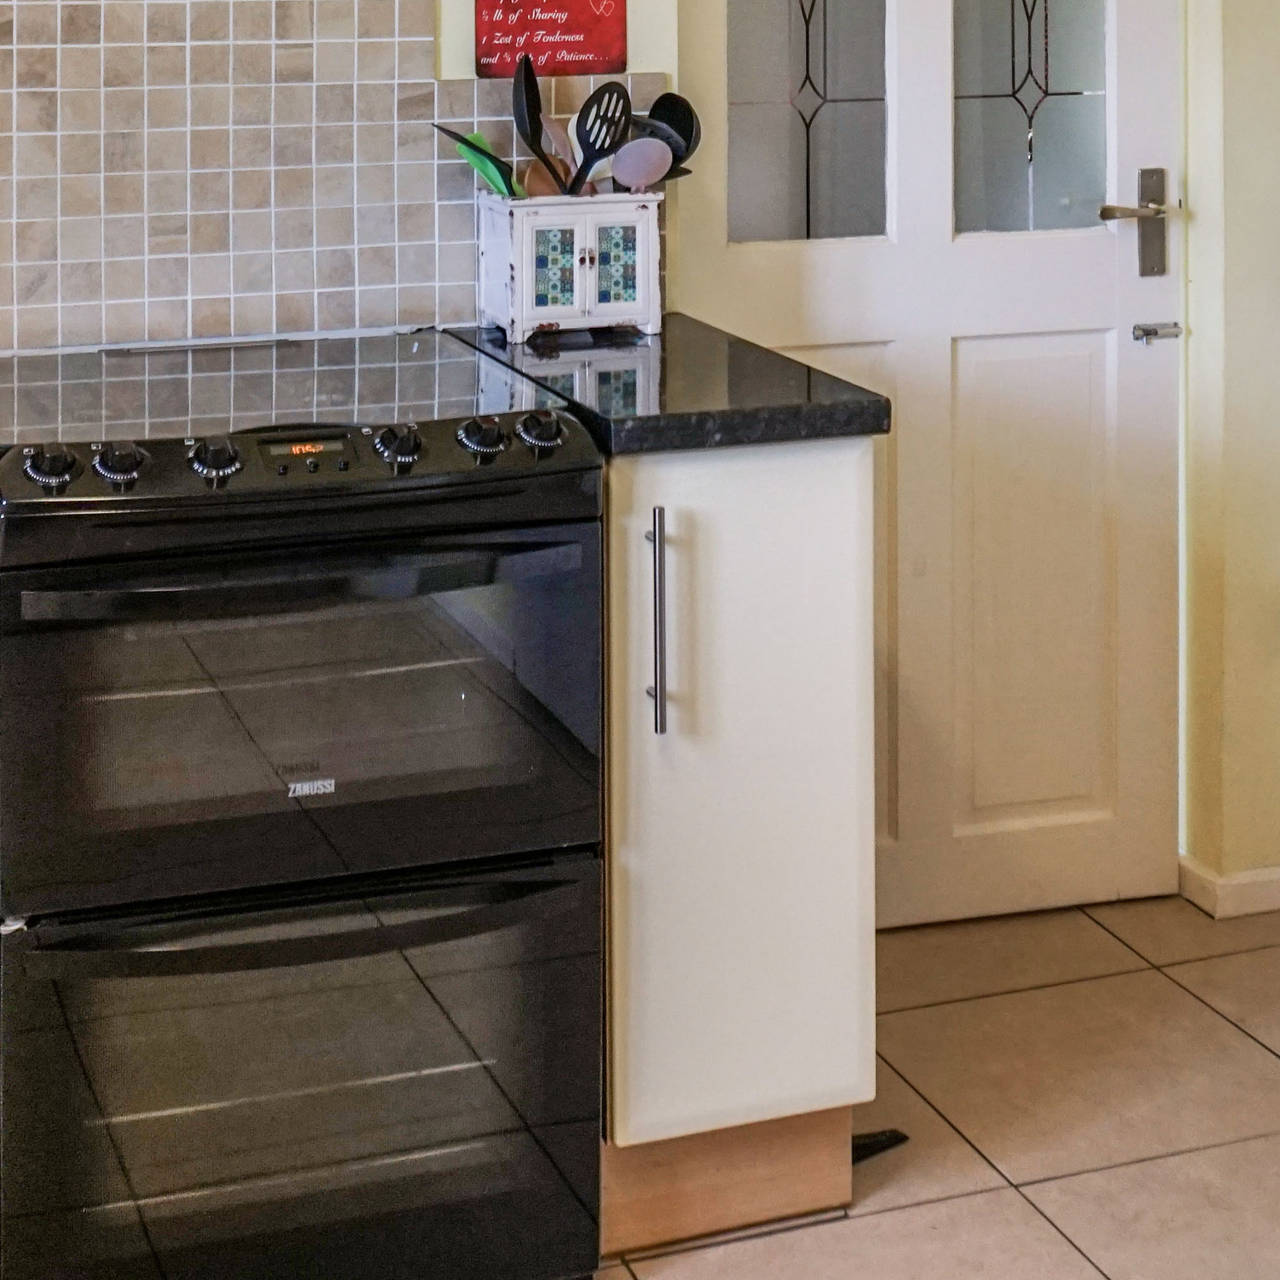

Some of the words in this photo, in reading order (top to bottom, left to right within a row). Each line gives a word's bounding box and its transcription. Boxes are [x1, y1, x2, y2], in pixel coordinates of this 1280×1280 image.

[493, 9, 503, 21] lb
[508, 9, 523, 24] of
[527, 7, 568, 23] Sharing
[493, 32, 512, 44] Zest
[515, 32, 530, 47] of
[533, 30, 584, 43] Tenderness
[480, 52, 500, 64] and
[538, 51, 552, 65] of
[288, 779, 335, 797] ZANUSSI
